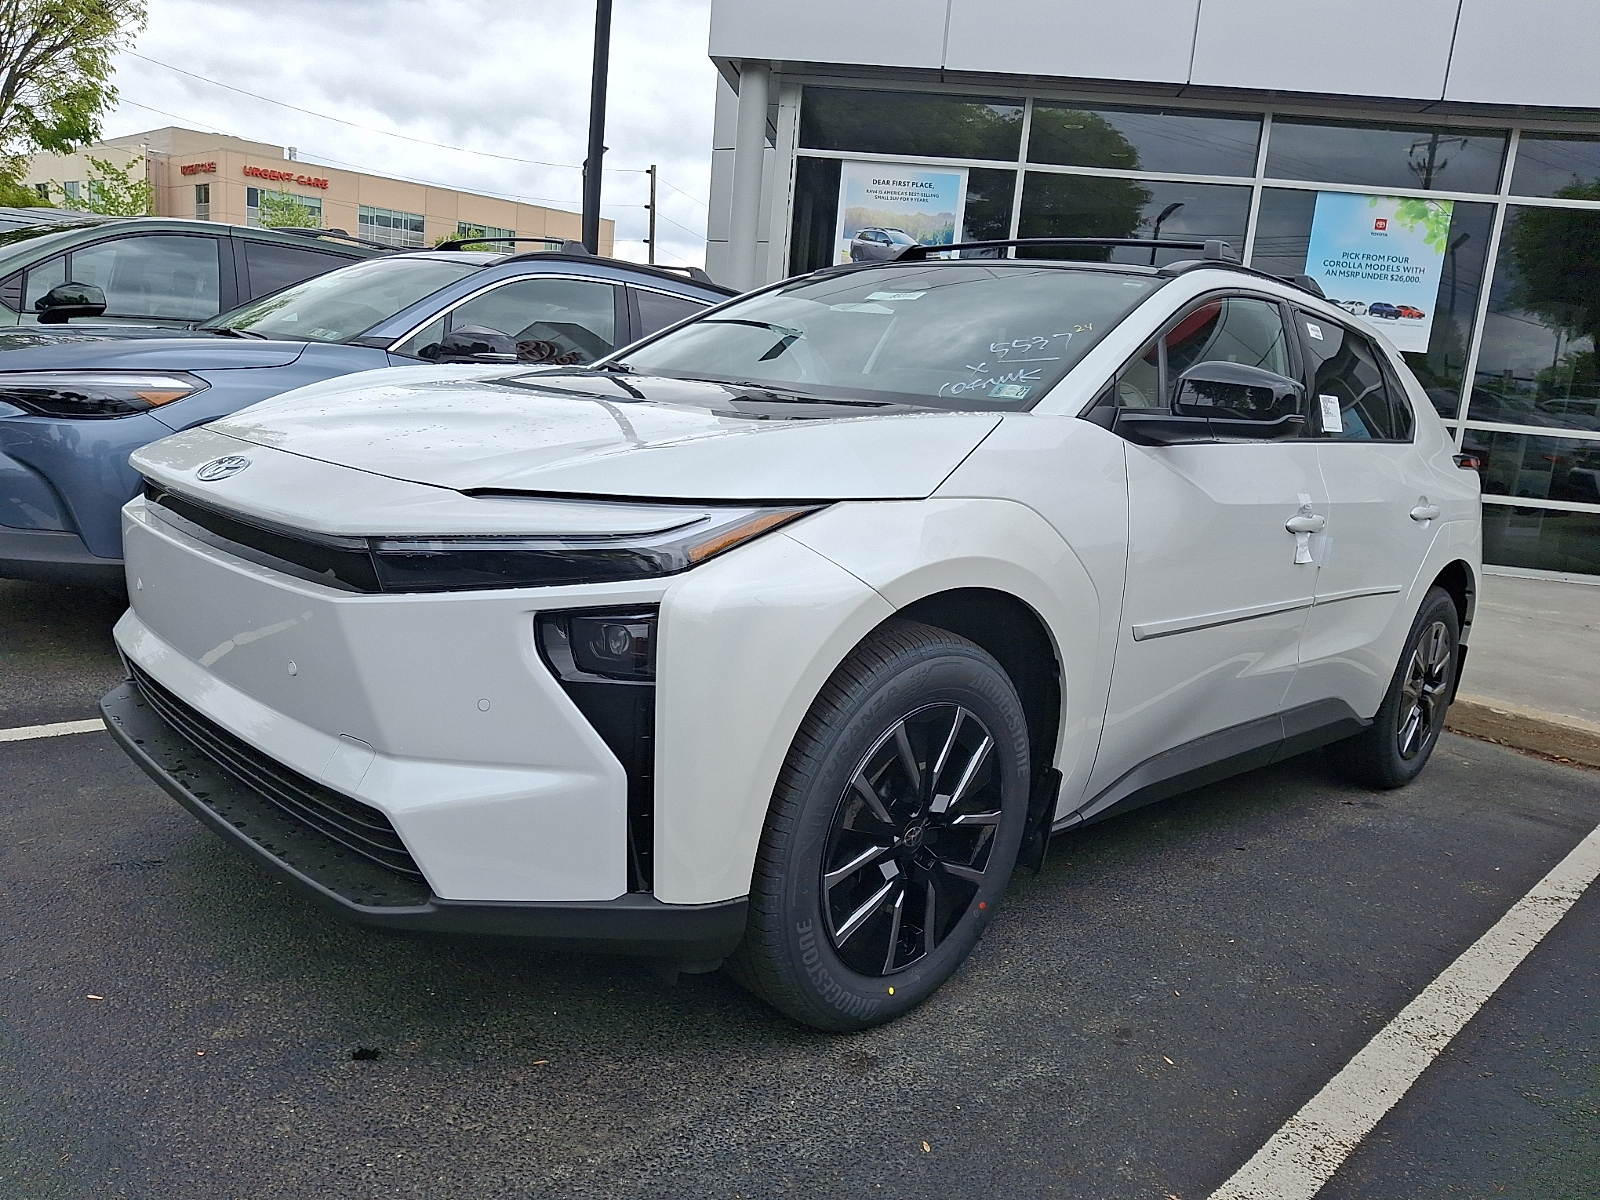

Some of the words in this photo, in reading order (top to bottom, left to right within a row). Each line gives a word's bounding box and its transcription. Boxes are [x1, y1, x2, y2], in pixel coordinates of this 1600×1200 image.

[243, 165, 294, 182] URGENT
[297, 174, 329, 189] CARE
[911, 181, 934, 189] PLACE,
[1341, 251, 1360, 260] PICK
[1361, 253, 1385, 262] FROM
[1386, 255, 1410, 264] FOUR
[1323, 259, 1363, 270] COROLLA
[1365, 262, 1401, 272] MODELS
[1402, 265, 1425, 275] WITH
[1325, 269, 1338, 277] AN
[1339, 270, 1360, 279] MSRP
[1361, 272, 1389, 281] UNDER
[1390, 274, 1422, 284] $26,000.
[1073, 323, 1093, 333] 24
[967, 670, 1029, 778] BRIDGESTONE
[795, 917, 882, 1021] BRIDGESTONE
